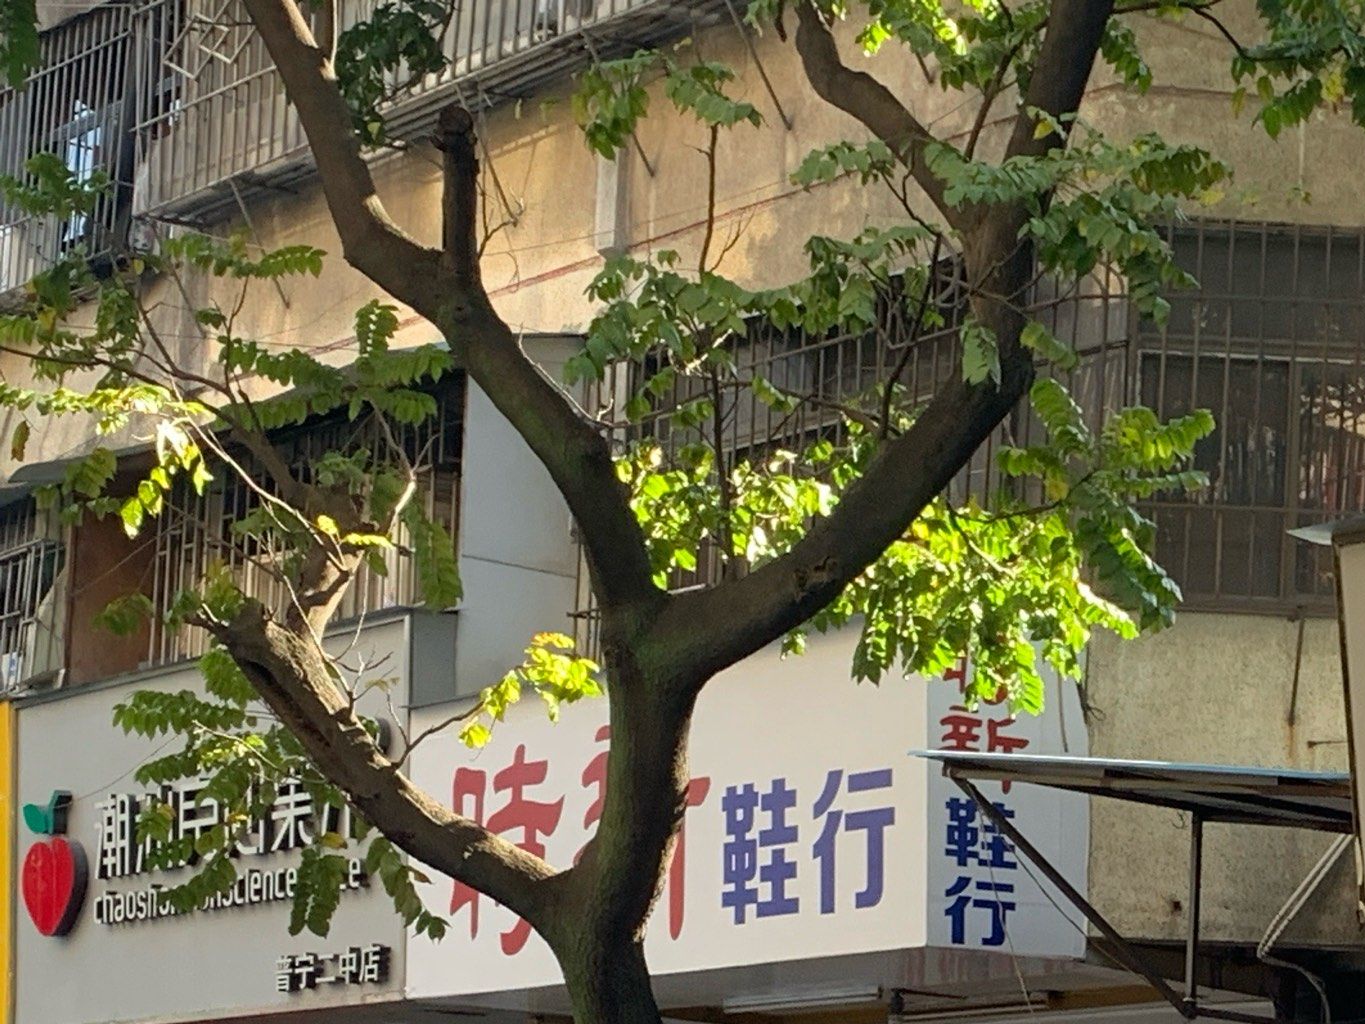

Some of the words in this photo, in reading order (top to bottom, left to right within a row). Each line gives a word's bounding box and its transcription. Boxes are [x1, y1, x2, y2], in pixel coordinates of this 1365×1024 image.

[275, 944, 381, 993] 普宁二中店
